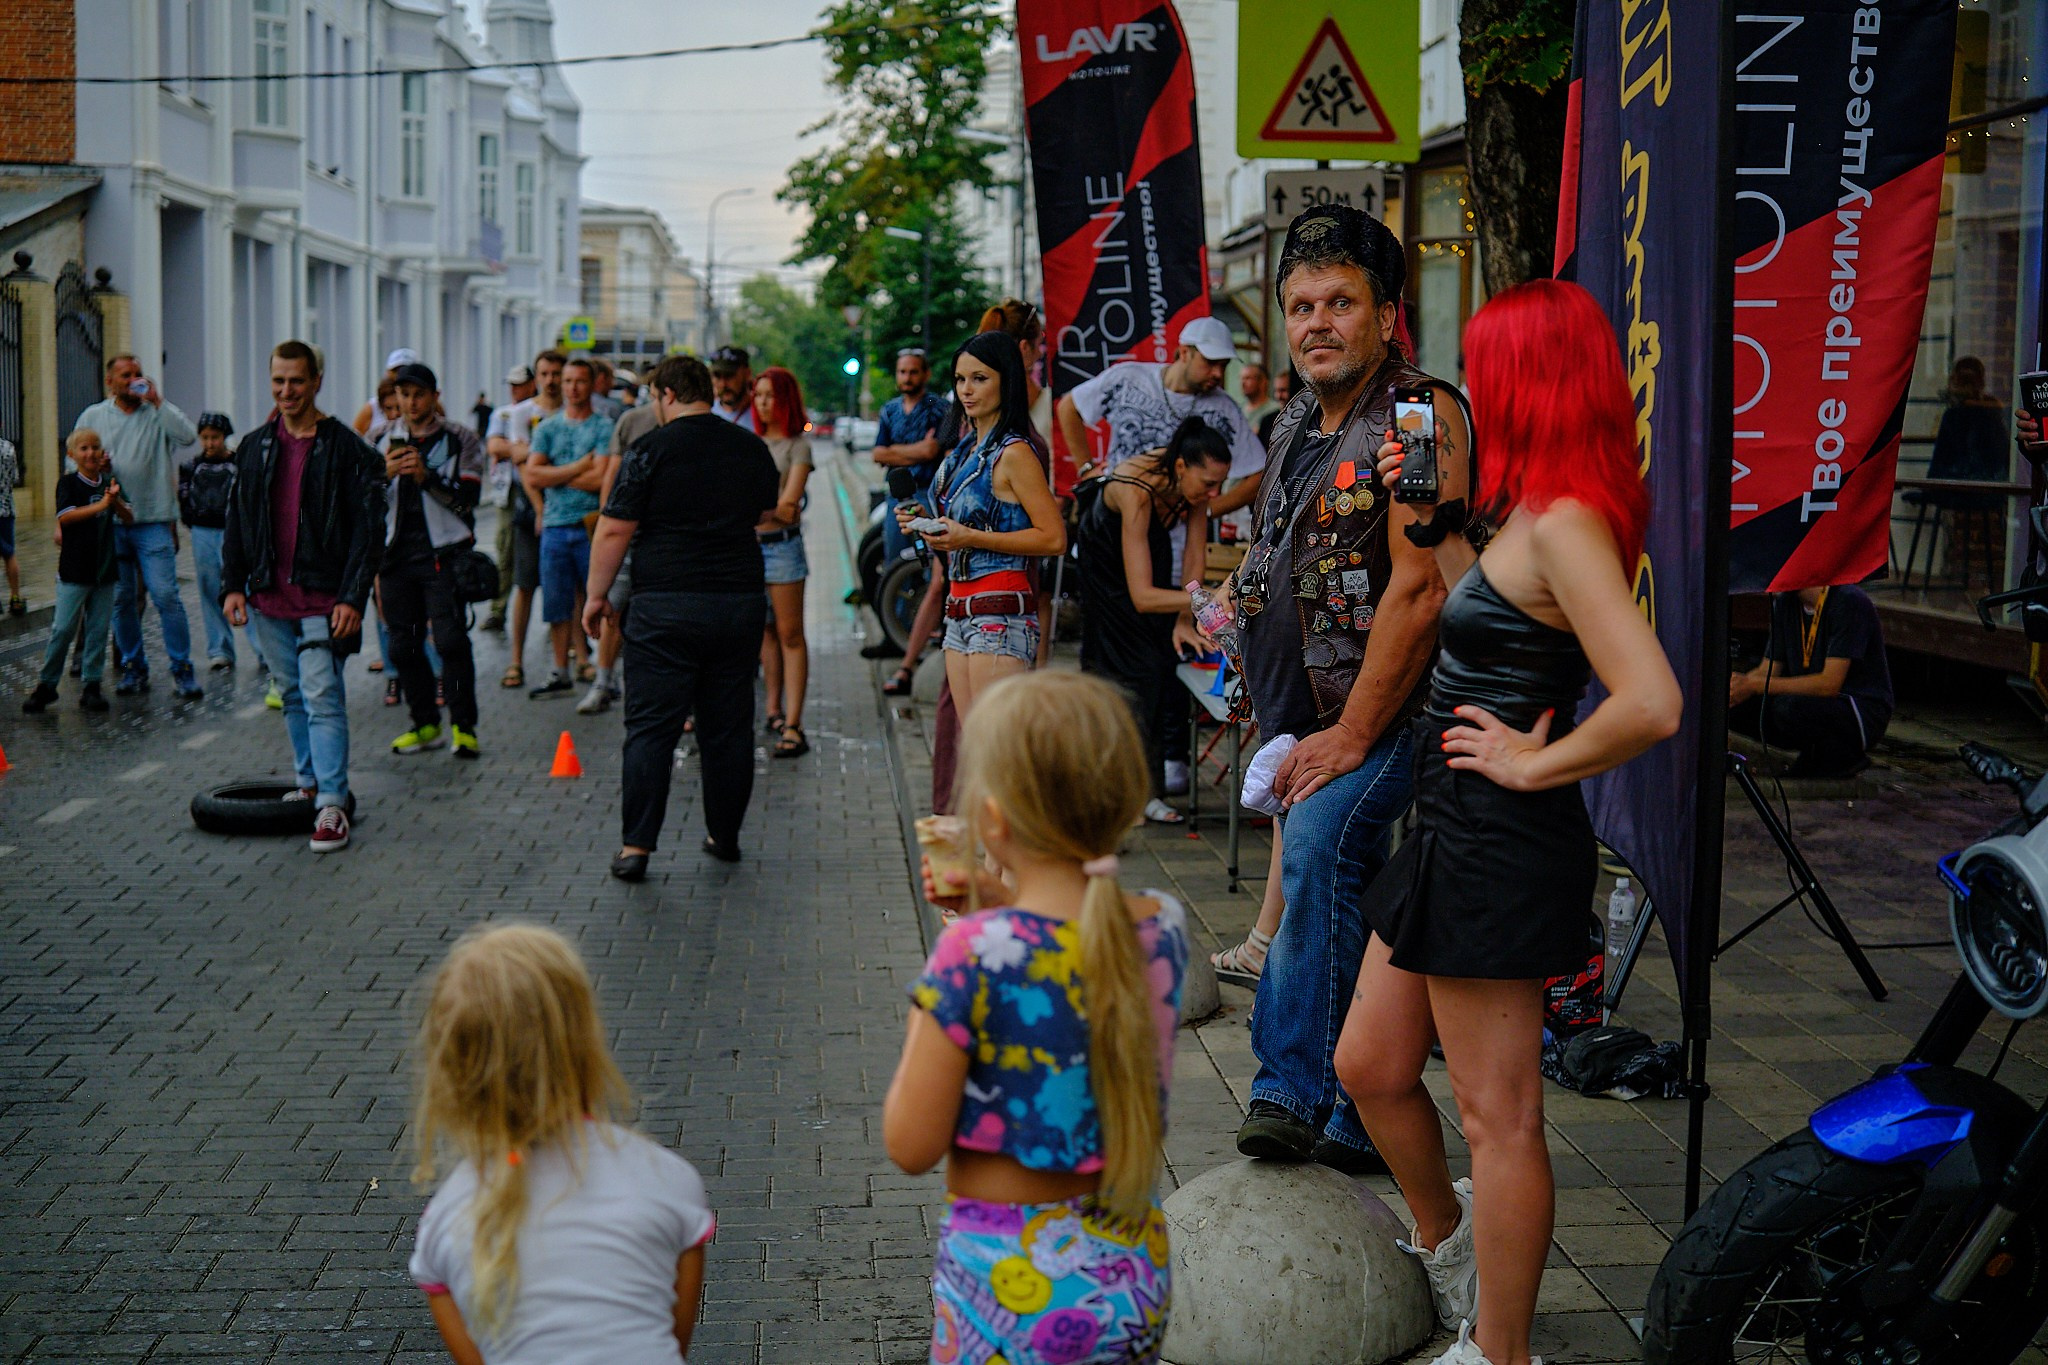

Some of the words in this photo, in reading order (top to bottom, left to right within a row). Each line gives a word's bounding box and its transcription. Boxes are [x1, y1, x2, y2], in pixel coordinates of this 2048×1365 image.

[1036, 22, 1157, 62] LAVR
[1821, 0, 1881, 381] преимуществ
[1800, 398, 1847, 523] Твое
